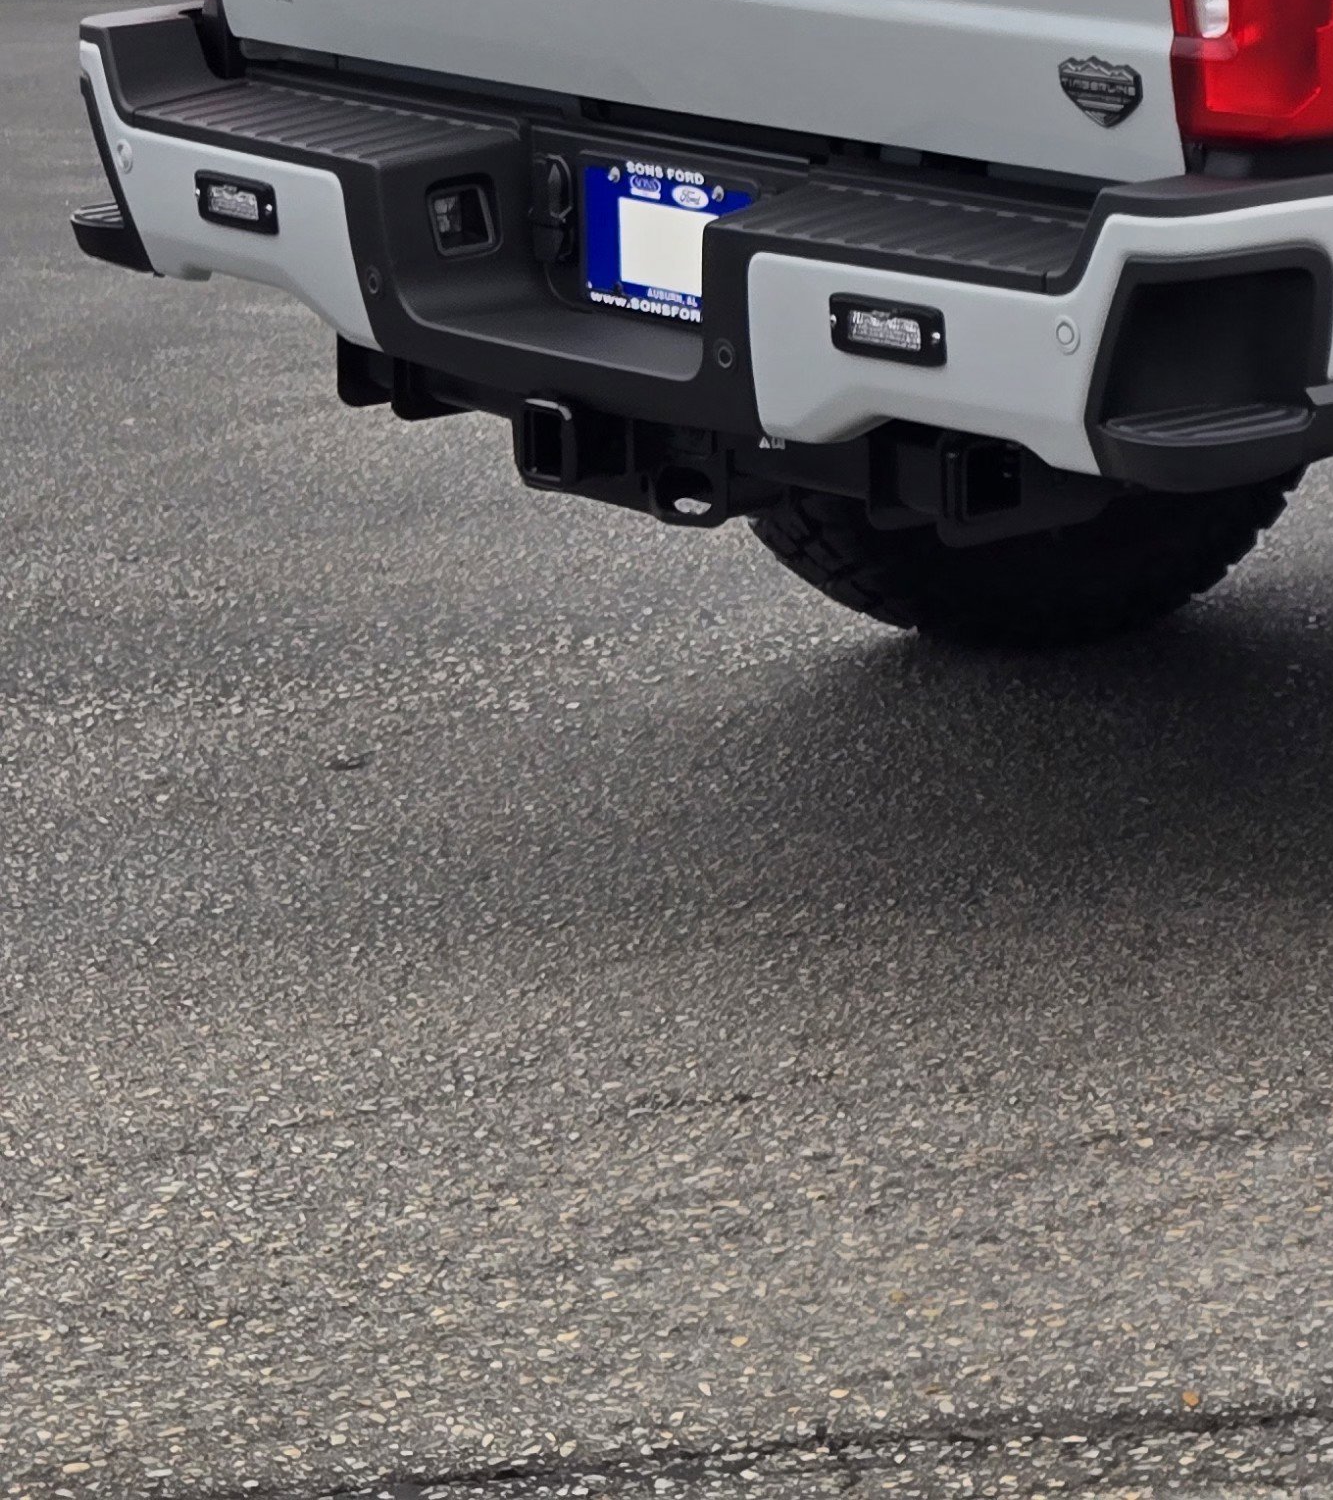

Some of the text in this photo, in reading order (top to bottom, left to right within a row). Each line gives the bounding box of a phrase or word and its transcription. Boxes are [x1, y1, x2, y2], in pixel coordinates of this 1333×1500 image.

[626, 160, 705, 186] SONS FORD
[589, 290, 703, 324] www.SONSFOR
